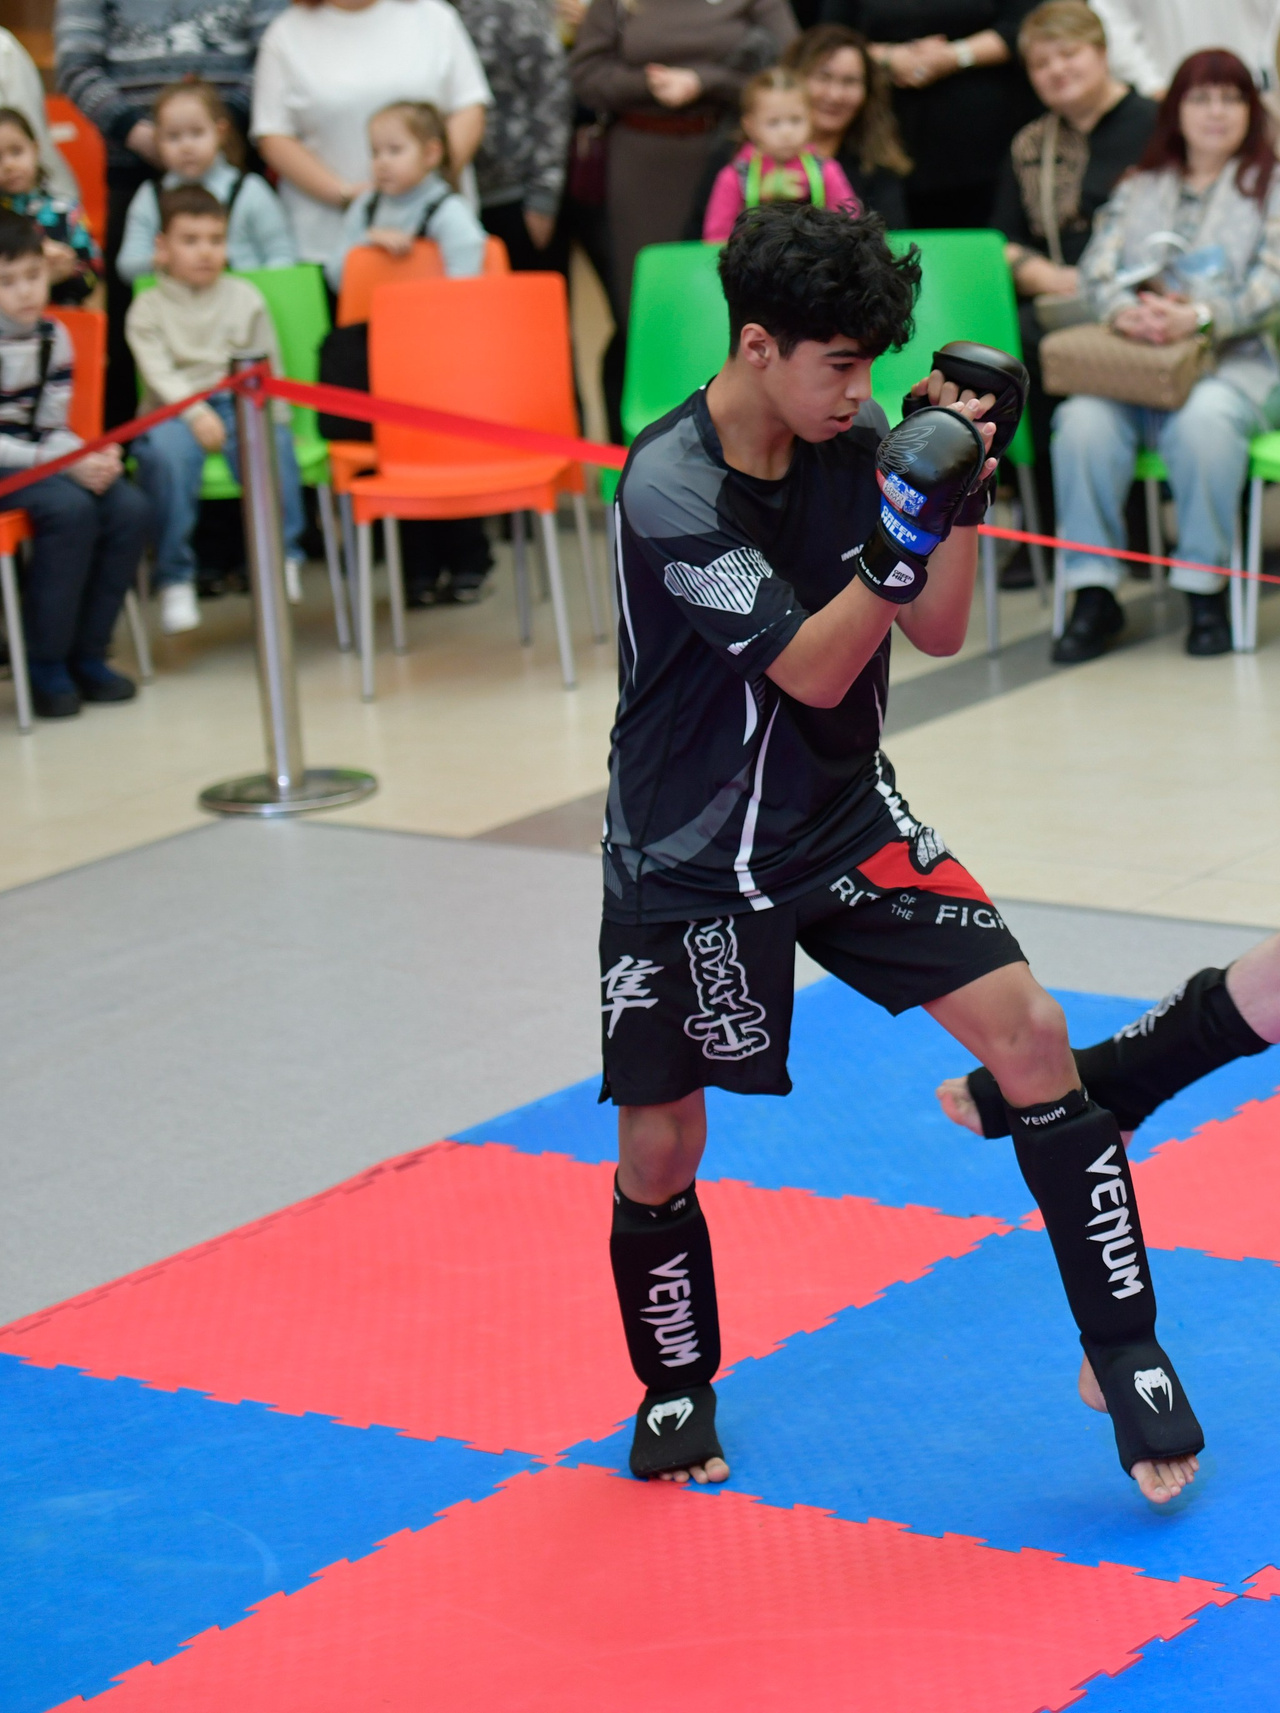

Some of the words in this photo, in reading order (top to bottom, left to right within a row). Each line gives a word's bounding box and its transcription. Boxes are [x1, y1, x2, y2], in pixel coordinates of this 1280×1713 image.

[881, 505, 918, 542] GREEN
[883, 514, 906, 544] HILL
[891, 573, 908, 584] HILL
[893, 569, 914, 581] GREEN
[899, 893, 917, 906] OF
[891, 904, 914, 921] THE
[1021, 1106, 1067, 1126] VENUM
[1085, 1144, 1145, 1300] VENUM
[639, 1251, 702, 1368] VENUM
